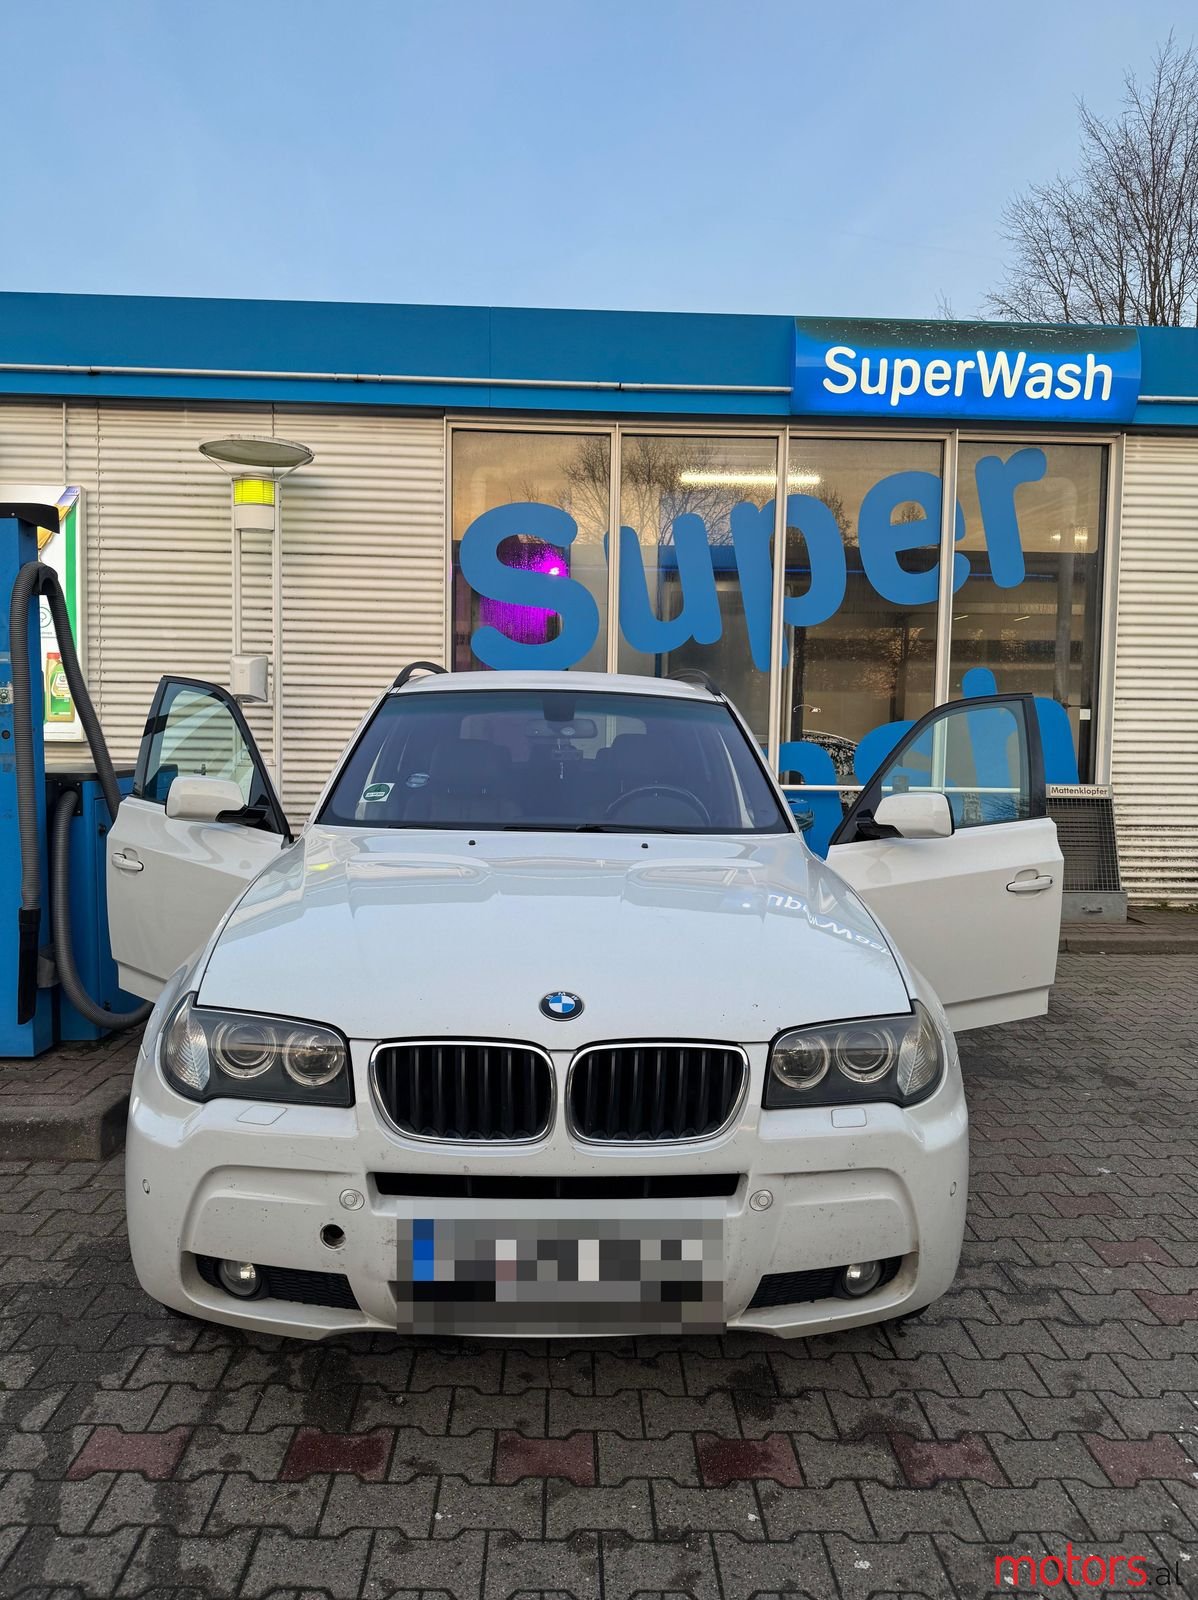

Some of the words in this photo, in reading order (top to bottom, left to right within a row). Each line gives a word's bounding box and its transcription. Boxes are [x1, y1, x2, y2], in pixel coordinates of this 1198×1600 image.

[822, 346, 1113, 406] SuperWash
[459, 447, 1048, 672] Super
[1051, 787, 1108, 796] Mattenklopfer
